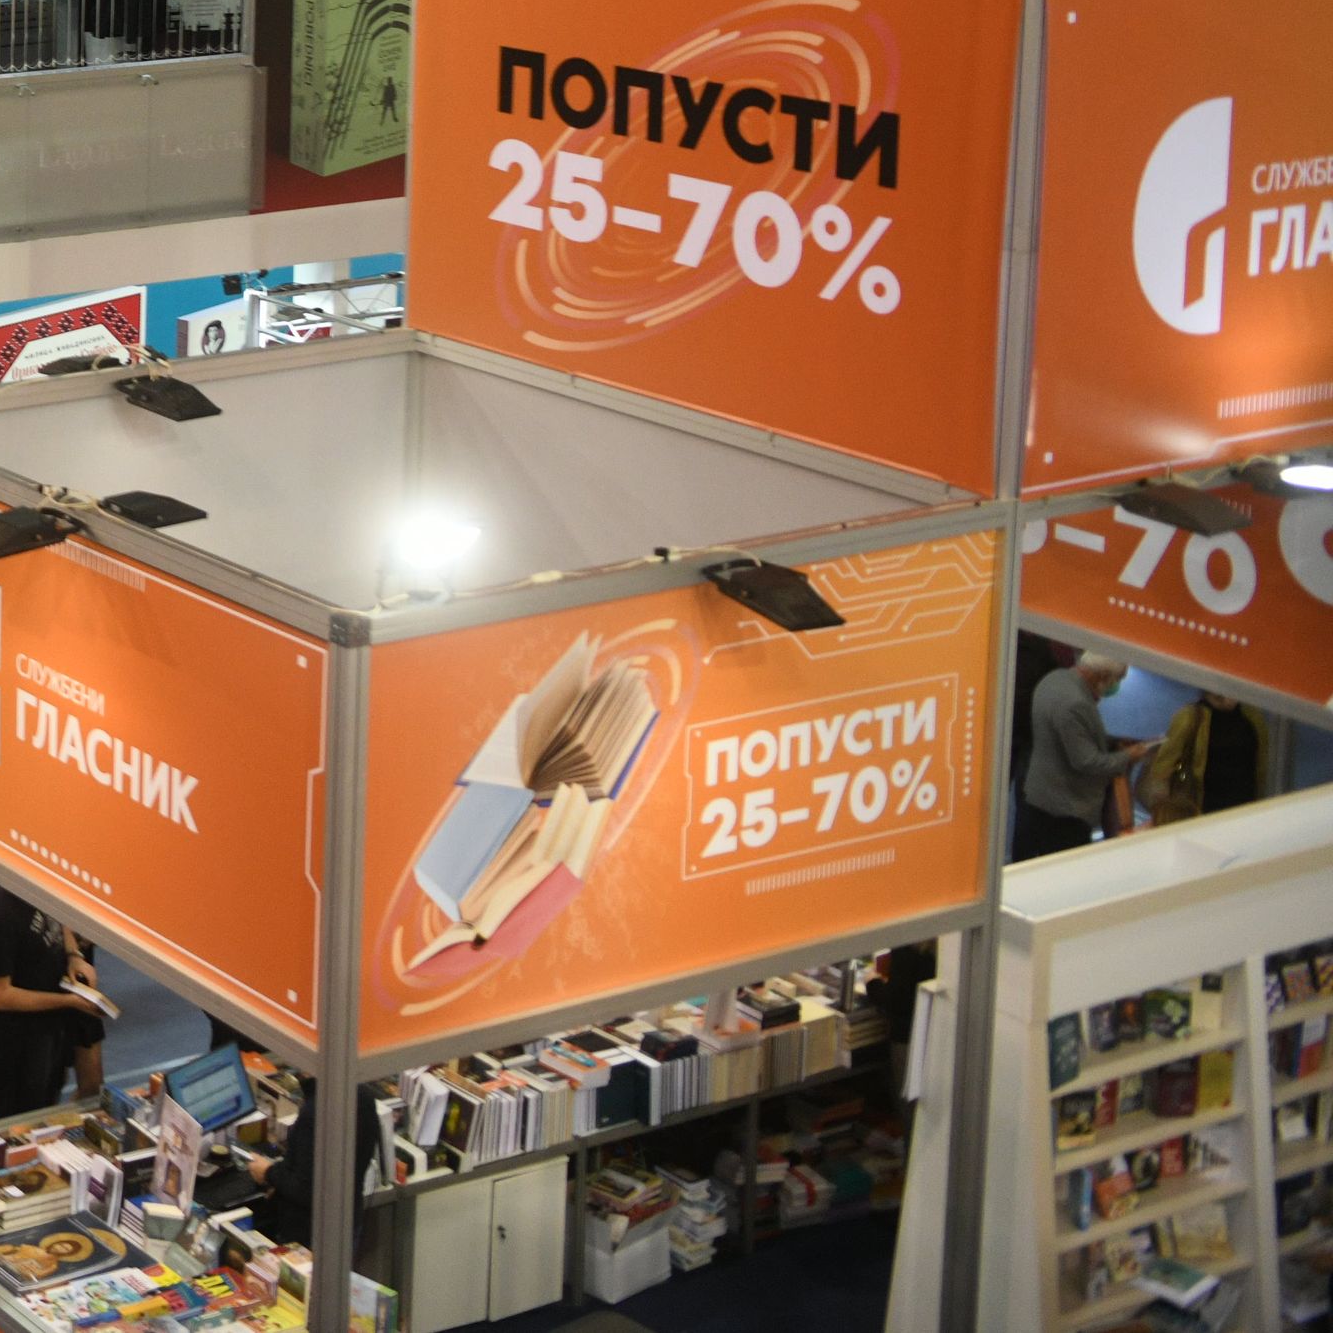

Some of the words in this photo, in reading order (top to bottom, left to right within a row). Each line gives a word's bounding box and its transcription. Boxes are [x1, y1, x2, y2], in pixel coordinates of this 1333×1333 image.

[497, 45, 900, 189] ПОПУСТИ
[15, 652, 105, 717] СЛУЖБЕНИ
[705, 696, 937, 787] ПОПУСТИ
[15, 687, 200, 835] ГЛАСНИК
